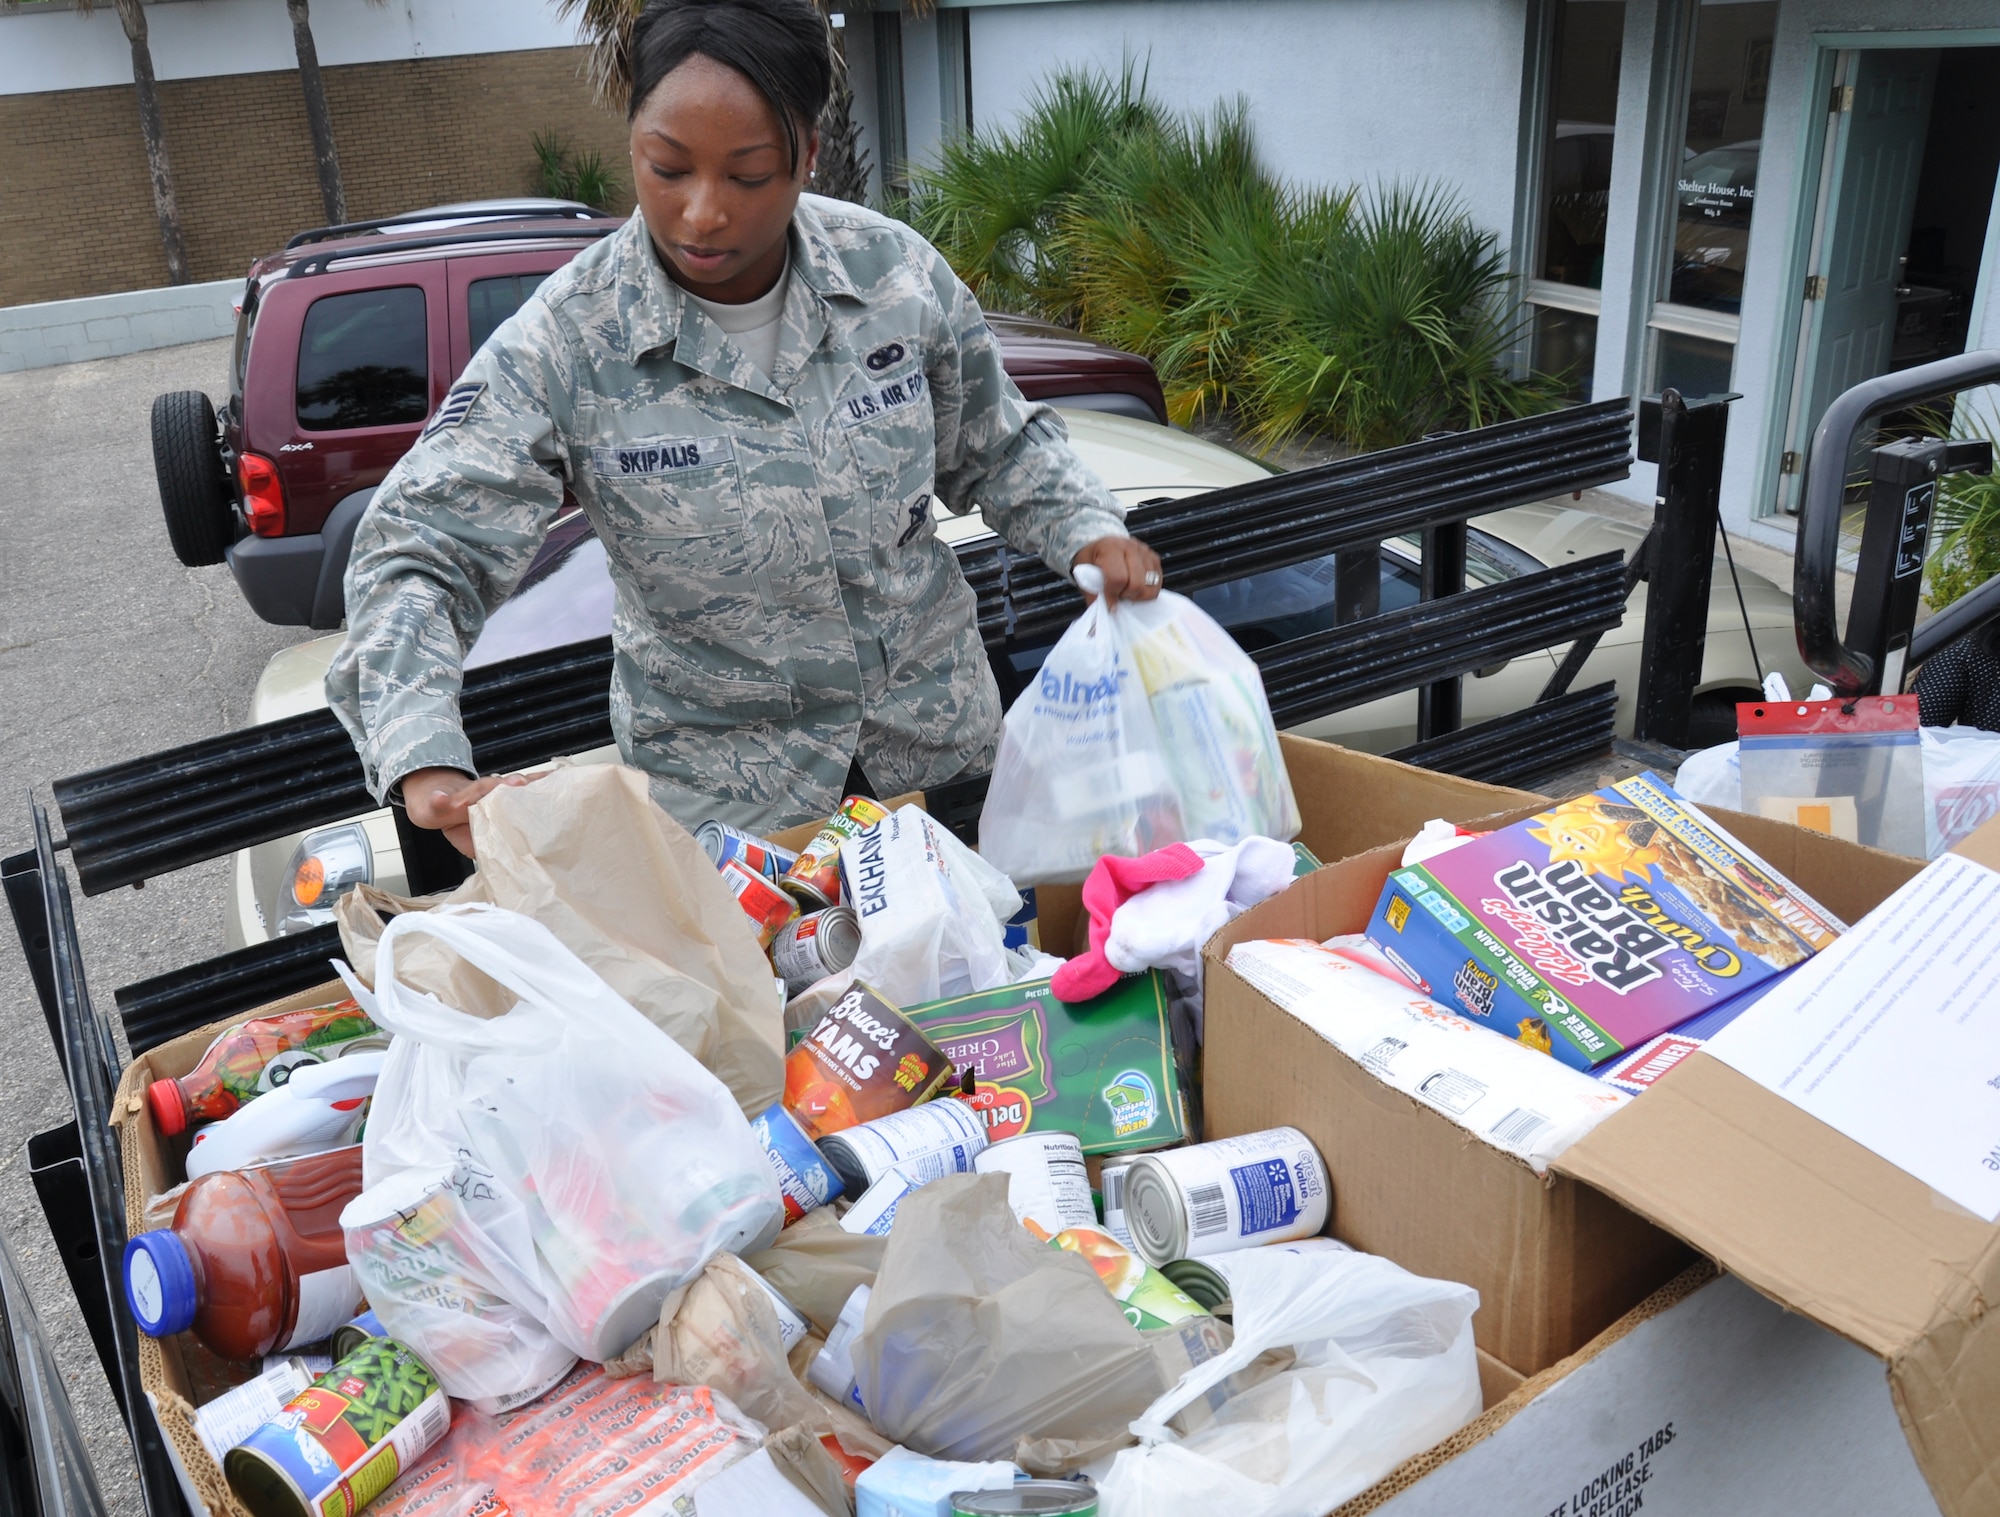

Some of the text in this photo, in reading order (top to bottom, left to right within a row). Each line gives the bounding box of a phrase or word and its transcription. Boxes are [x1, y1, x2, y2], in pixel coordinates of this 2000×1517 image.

[1678, 179, 1706, 193] Shelter
[1708, 183, 1737, 197] House,
[847, 394, 880, 419] U.S.
[880, 383, 906, 408] AIR
[620, 444, 701, 474] SKIPALIS
[856, 803, 868, 812] NO
[1628, 780, 1739, 865] RAISIN BRAN
[1496, 865, 1654, 990] Raisin
[1542, 860, 1668, 958] Bran
[1769, 895, 1826, 941] WIN
[1478, 898, 1591, 987] Kellogg's
[1619, 884, 1743, 979] Crunch
[1467, 958, 1497, 989] Crunch
[1471, 927, 1540, 988] WHOLE GRAIN
[1454, 973, 1491, 1014] Raisin
[1461, 966, 1491, 1000] Bran
[1504, 967, 1530, 991] Made with
[1672, 968, 1699, 992] Two
[827, 988, 900, 1053] Bruce's
[1558, 1019, 1596, 1053] Good Source of
[1563, 1013, 1606, 1050] FIBER
[810, 1015, 881, 1083] YAMS
[992, 1049, 1014, 1062] Lake
[995, 1057, 1017, 1069] Blue
[1630, 1044, 1693, 1082] SKINNER
[814, 1049, 839, 1072] POTATOES
[836, 1067, 845, 1077] IN
[842, 1073, 862, 1092] SYRUP
[893, 1068, 916, 1092] YAM
[993, 1101, 1023, 1126] Del
[1115, 1108, 1145, 1122] Pantry
[1115, 1118, 1147, 1131] NEW!
[1116, 1098, 1149, 1114] Perfect
[1294, 1162, 1309, 1199] Value
[1297, 1150, 1322, 1197] Great
[1273, 1185, 1281, 1222] Guaranteed.
[869, 1216, 885, 1233] ME
[1573, 1422, 1677, 1513] LOCKING TABS.
[1590, 1462, 1653, 1517] RELEASE.
